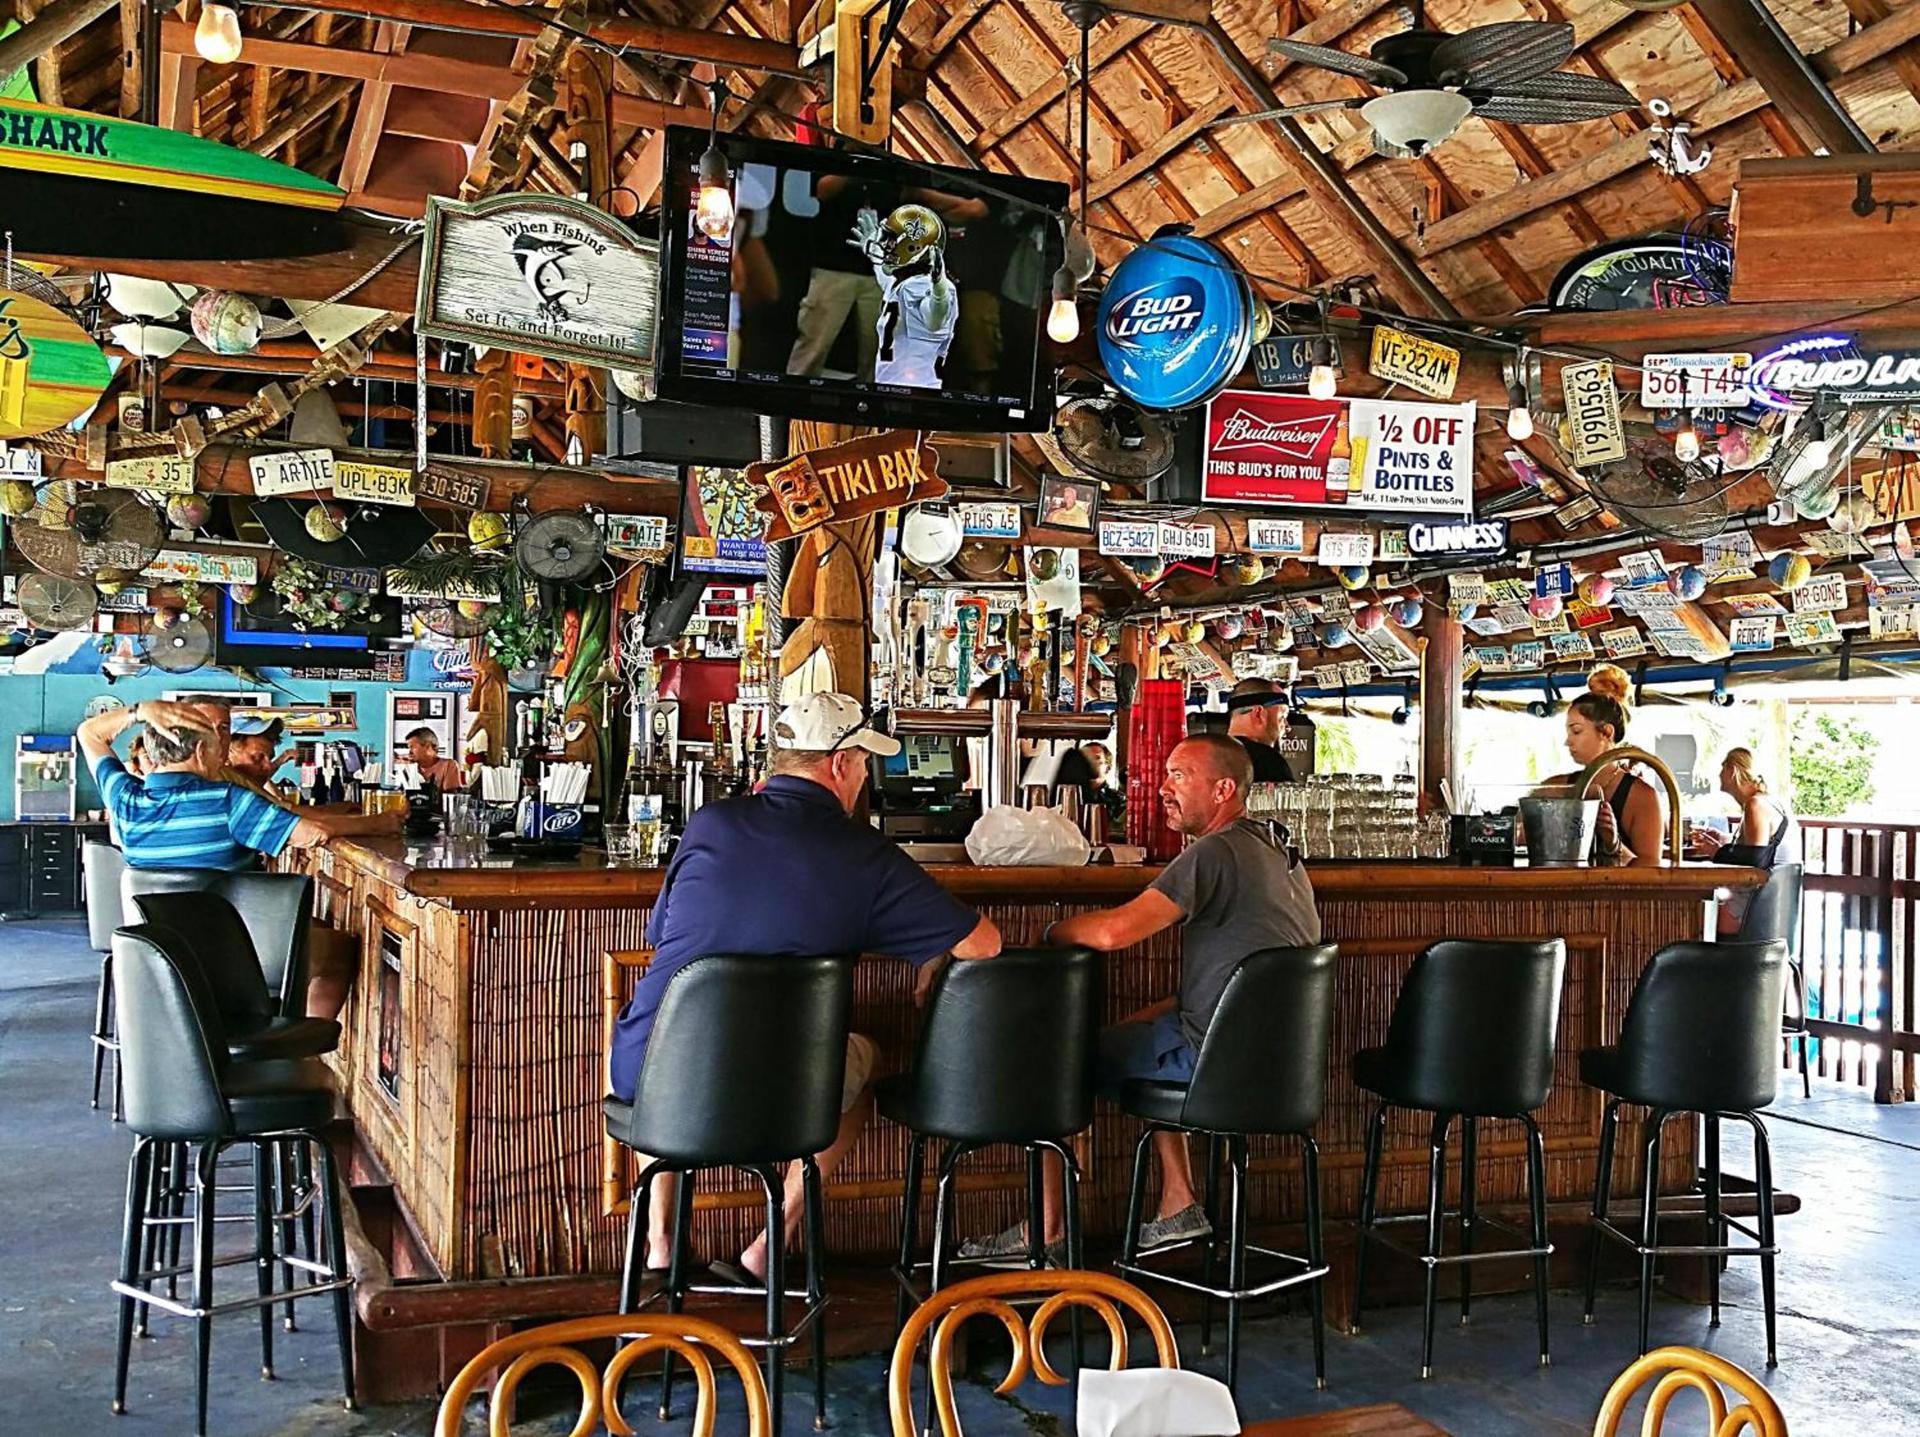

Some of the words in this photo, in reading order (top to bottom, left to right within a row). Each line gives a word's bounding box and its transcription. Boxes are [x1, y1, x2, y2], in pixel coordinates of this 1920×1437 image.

[0, 110, 110, 158] SHARK
[501, 221, 549, 238] When
[552, 222, 608, 256] Fishing
[1571, 266, 1622, 307] PREUM
[1621, 255, 1701, 274] QUALITY
[1133, 294, 1192, 316] BUD
[464, 308, 489, 324] Set
[517, 320, 548, 335] and
[552, 325, 603, 346] Forget
[608, 332, 626, 350] It!
[1119, 312, 1200, 338] LIGHT
[682, 336, 702, 344] Saints
[701, 345, 714, 353] Ago
[1258, 344, 1281, 371] JB
[1647, 359, 1664, 367] SEP
[1669, 357, 1728, 367] Massachusetts
[1766, 359, 1868, 388] BUD
[1602, 384, 1618, 437] LOUISIANA
[1224, 417, 1322, 445] Budweiser
[1413, 416, 1463, 446] OFF
[1379, 447, 1430, 470] PINTS
[1436, 451, 1454, 470] &
[162, 462, 180, 481] 35
[255, 467, 266, 486] P
[279, 459, 333, 483] ARTIE
[819, 458, 877, 503] TIKI
[878, 449, 929, 491] BAR
[1209, 460, 1236, 475] THIS
[1238, 463, 1272, 477] BUD'S
[1275, 466, 1297, 479] FOR
[1299, 468, 1324, 481] YOU.
[1375, 469, 1455, 493] BOTTLES
[353, 492, 376, 500] Garden
[965, 514, 993, 530] RIHS
[1001, 515, 1015, 530] 45
[721, 542, 745, 550] WANT
[1103, 530, 1155, 547] BCZ-5427
[1257, 530, 1294, 545] NEETAS
[1409, 523, 1504, 551] GUINNESS
[721, 549, 746, 557] MAYBE
[1880, 614, 1899, 633] MUG
[1736, 627, 1767, 645] REDEYE
[551, 812, 576, 829] Lite
